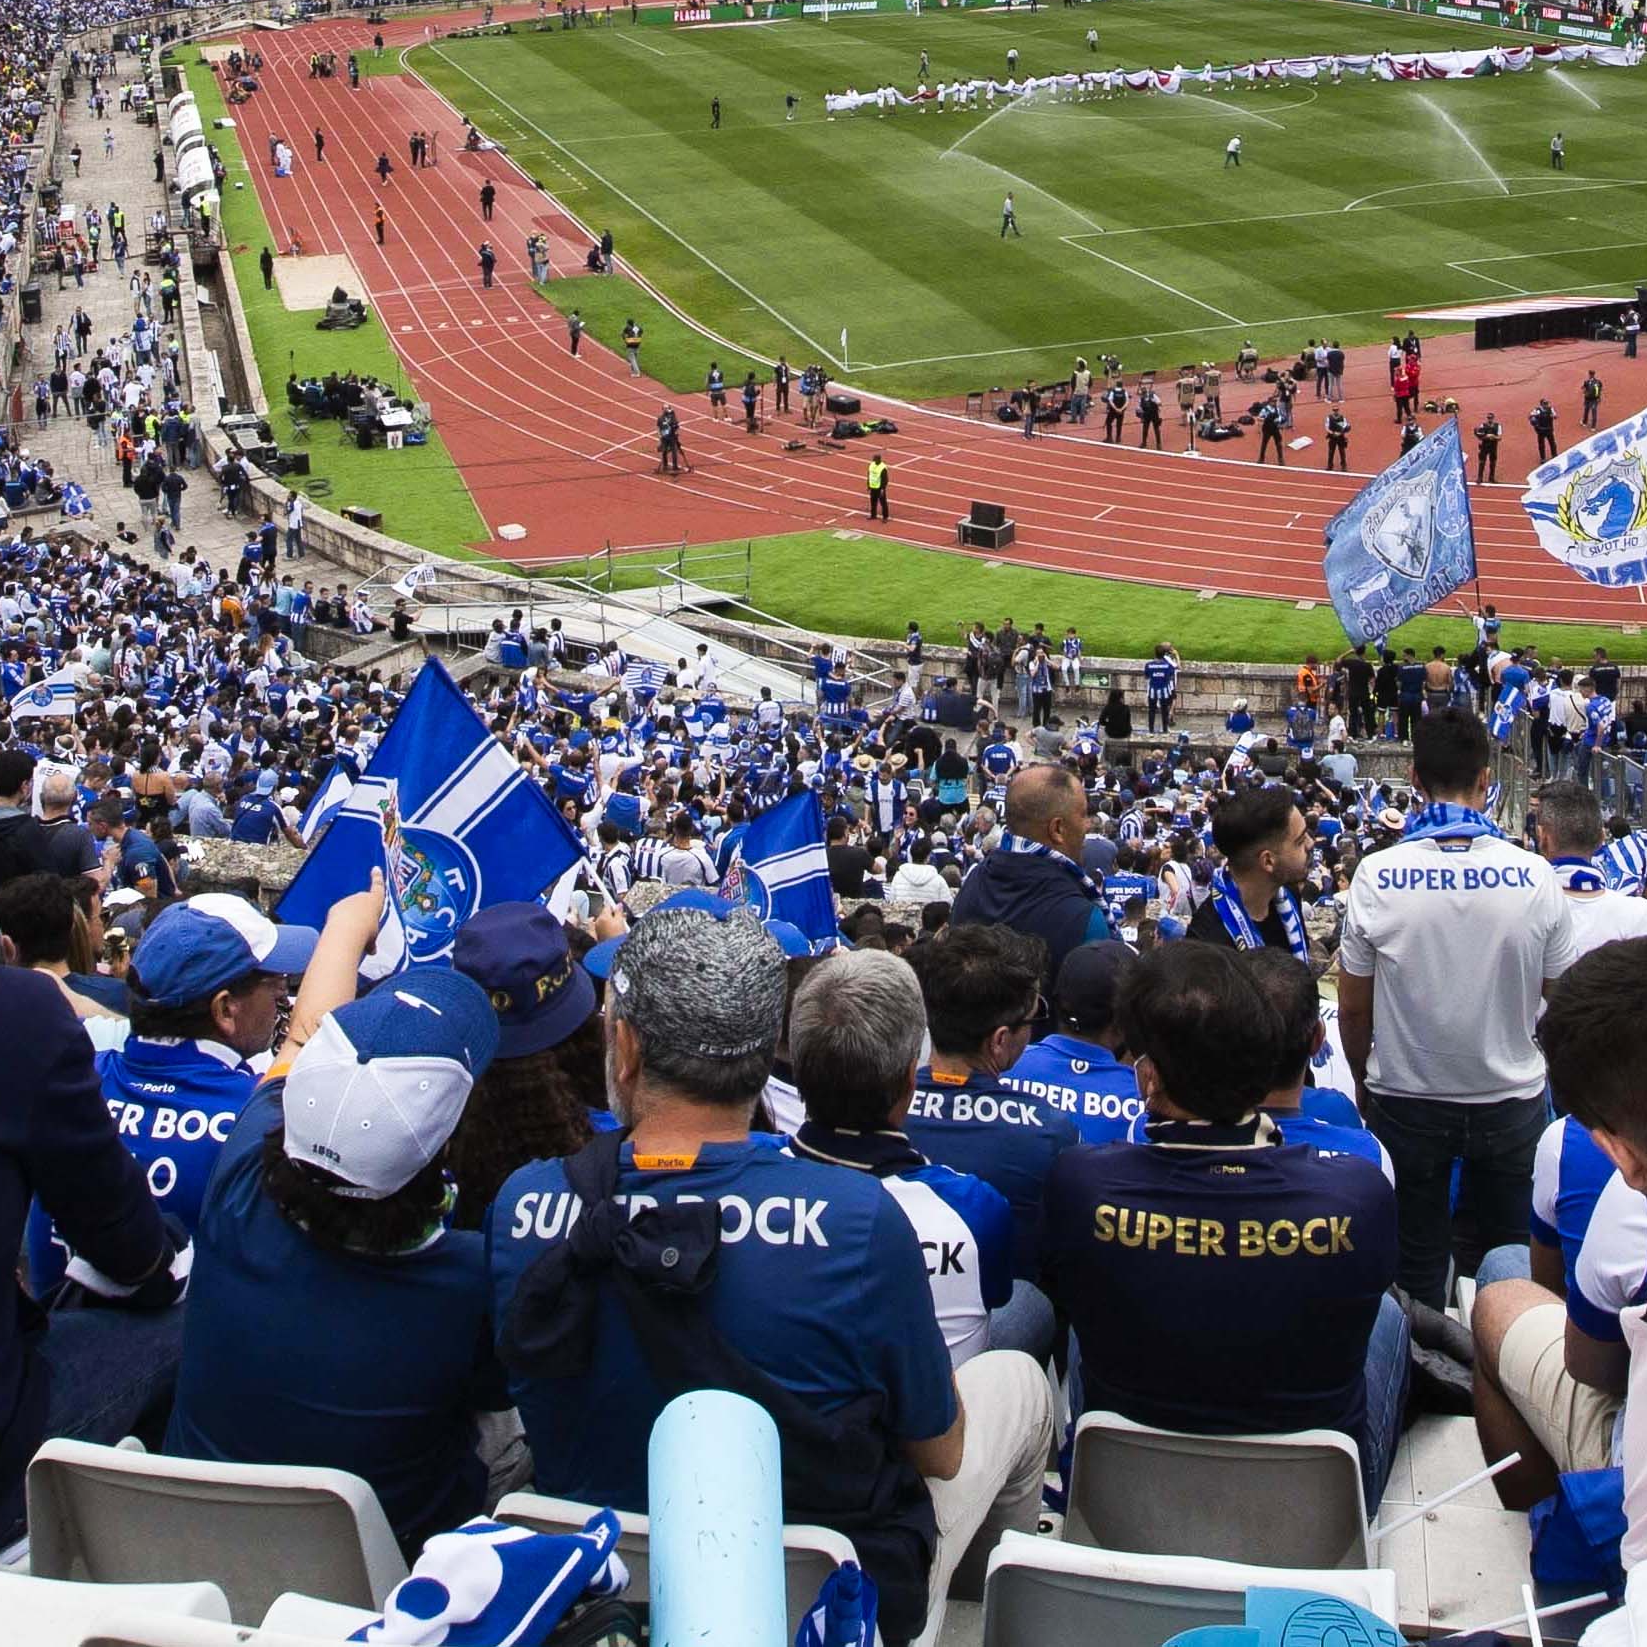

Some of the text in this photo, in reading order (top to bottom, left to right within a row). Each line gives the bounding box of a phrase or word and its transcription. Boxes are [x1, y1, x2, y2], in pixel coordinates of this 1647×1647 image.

[1377, 866, 1535, 890] SUPER BOCK
[1106, 887, 1143, 896] SUPER BOCK
[952, 1094, 1043, 1127] BOCK
[1222, 1164, 1246, 1175] Porto
[1094, 1204, 1355, 1257] SUPER BOCK
